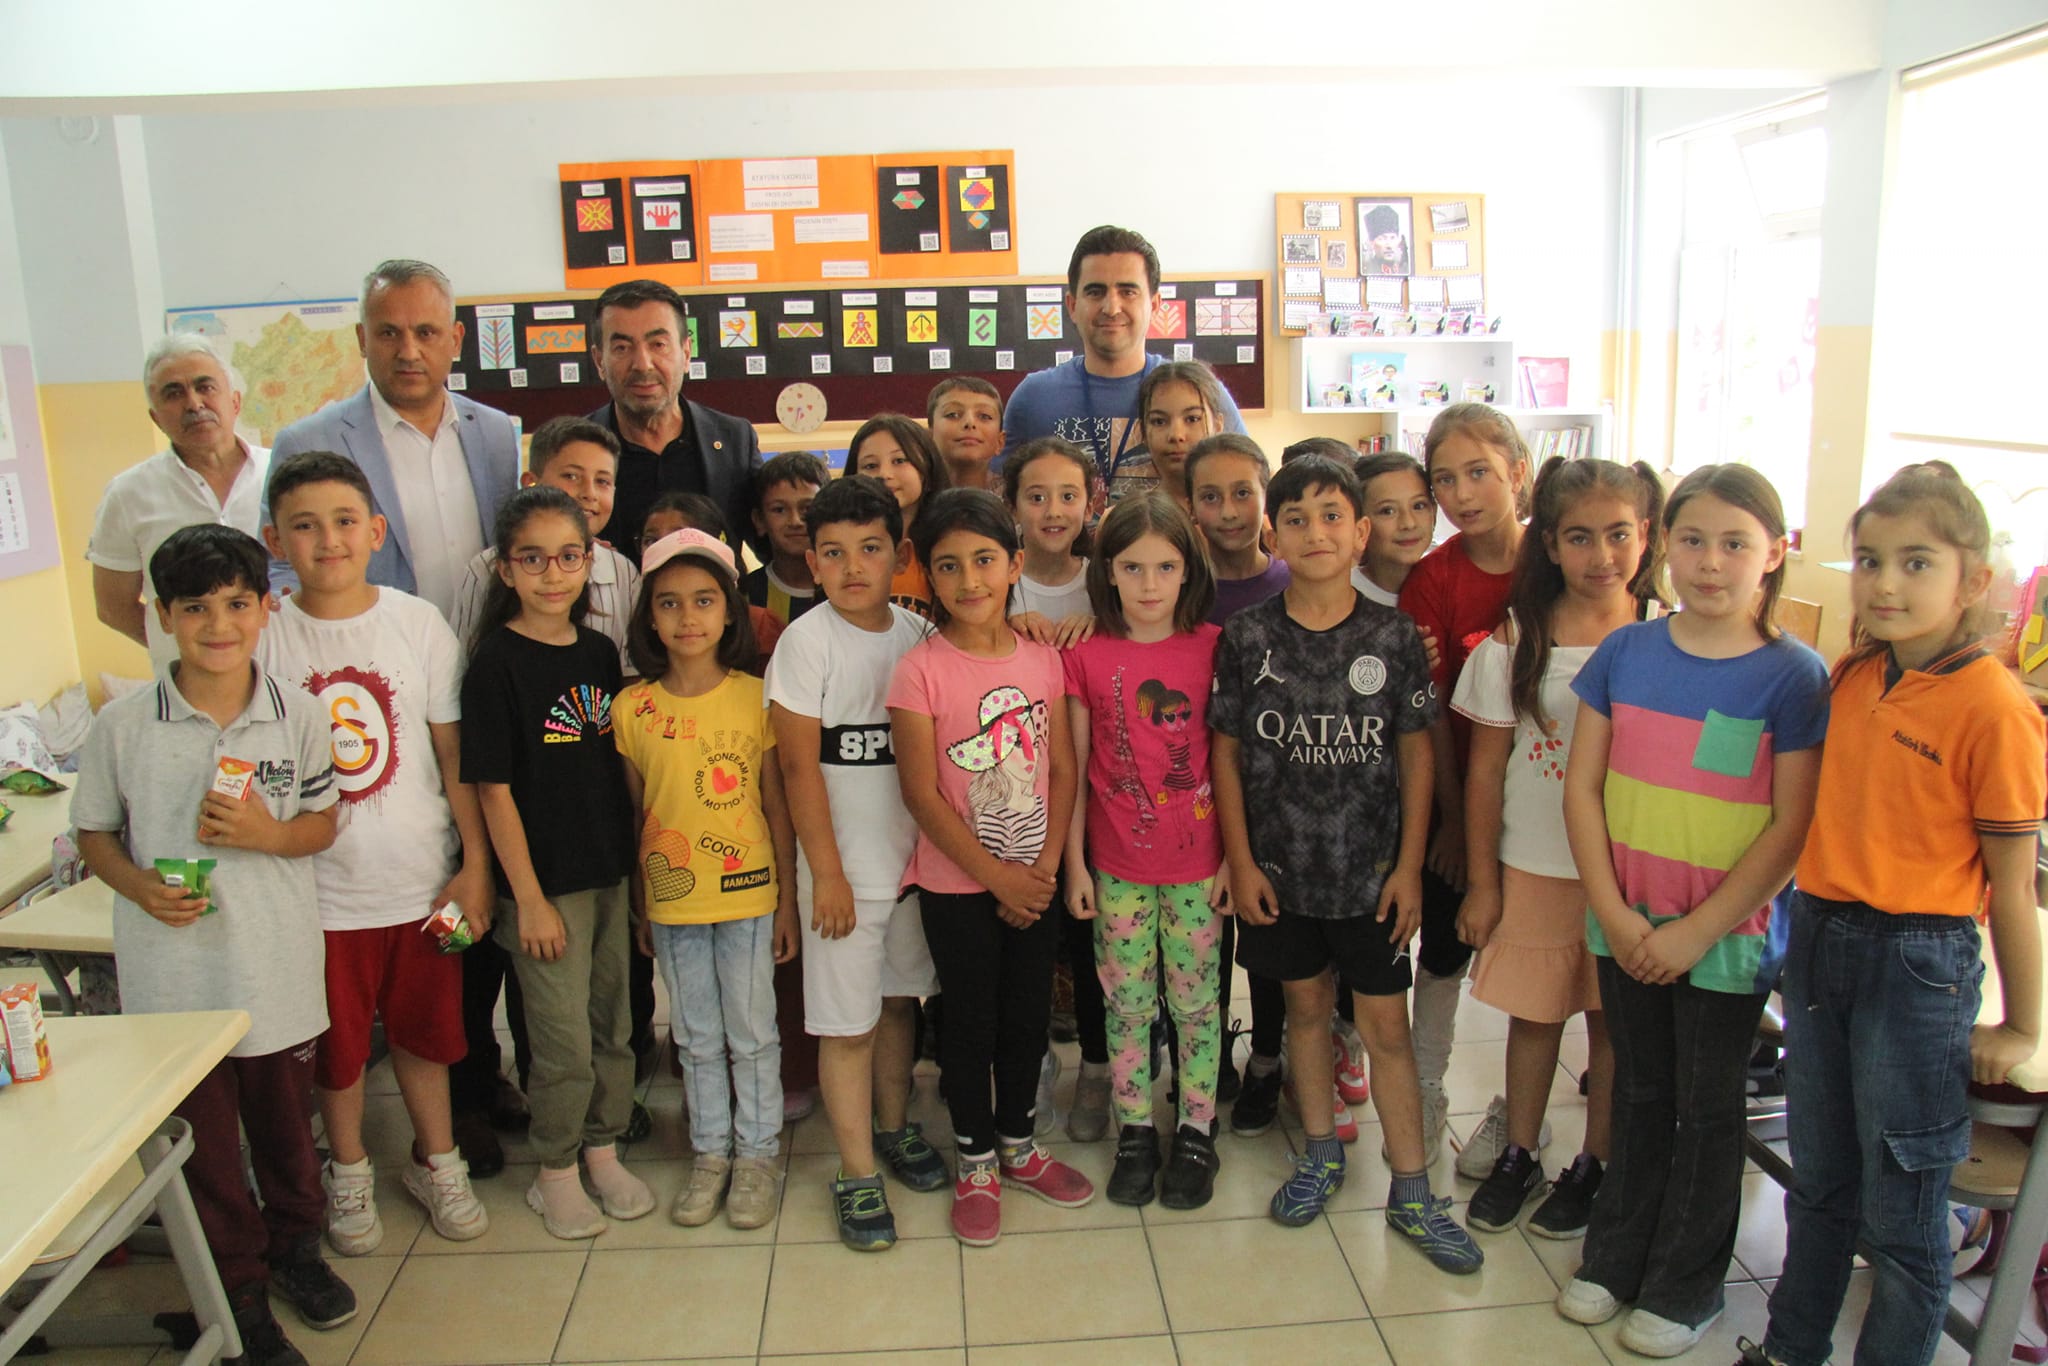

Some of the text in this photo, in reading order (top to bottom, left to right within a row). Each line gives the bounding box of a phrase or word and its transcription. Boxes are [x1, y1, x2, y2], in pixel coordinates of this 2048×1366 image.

[1256, 709, 1384, 749] QATAR
[338, 740, 359, 749] 1905
[1290, 745, 1384, 766] AIRWAYS
[700, 836, 740, 861] COOL
[722, 871, 769, 889] #AMAZING
